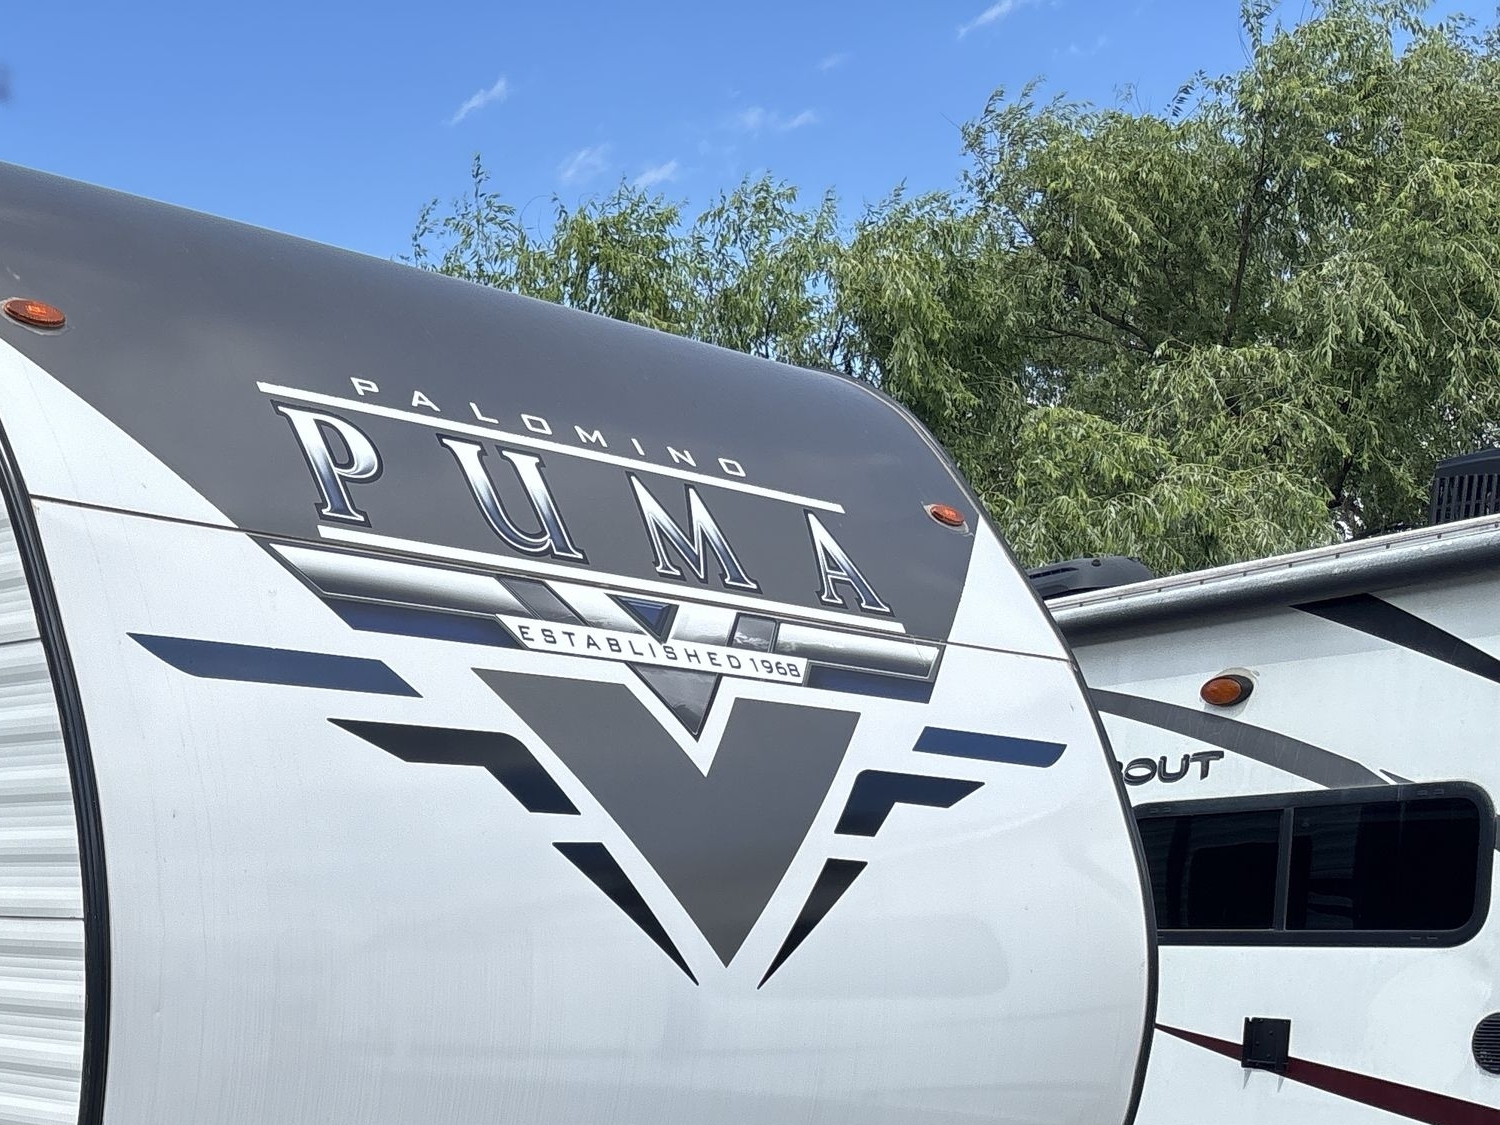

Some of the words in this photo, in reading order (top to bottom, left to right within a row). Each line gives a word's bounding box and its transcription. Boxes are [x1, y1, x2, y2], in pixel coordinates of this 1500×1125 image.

[350, 376, 747, 478] PALOMINO
[269, 399, 896, 618] PUMA
[517, 624, 742, 670] ESTABLISHED
[749, 657, 801, 678] 1968
[1117, 750, 1224, 786] OUT
